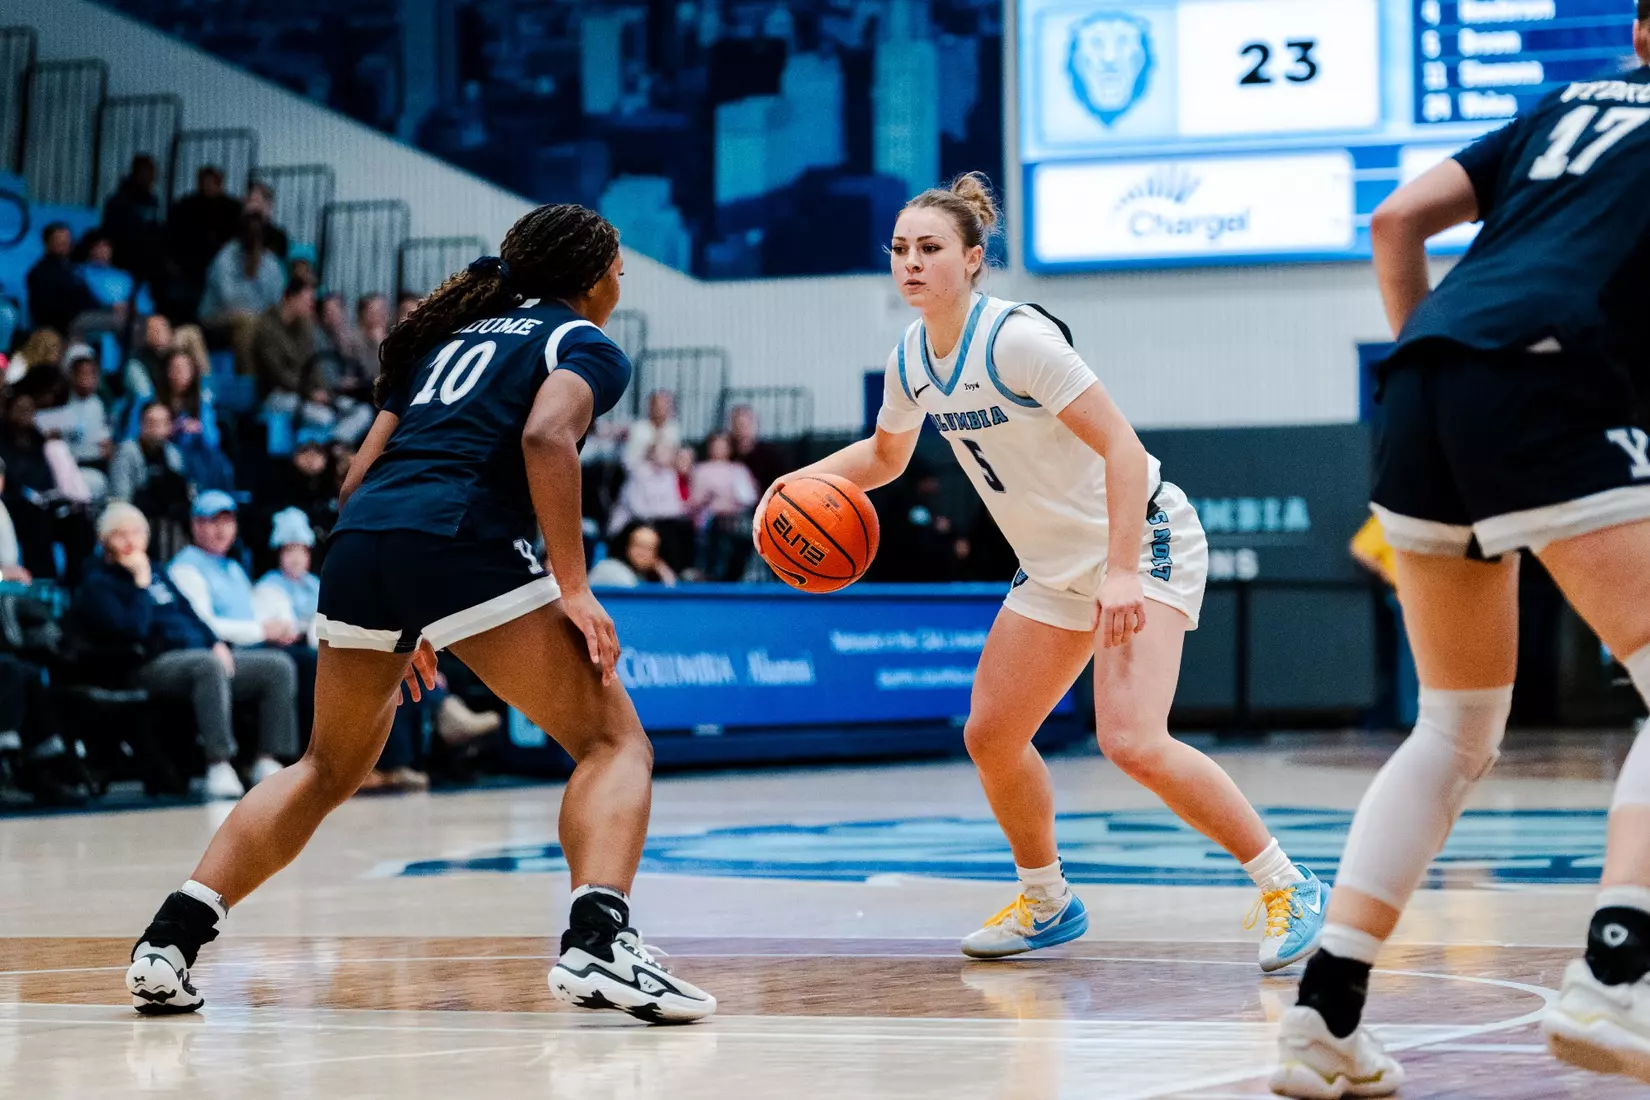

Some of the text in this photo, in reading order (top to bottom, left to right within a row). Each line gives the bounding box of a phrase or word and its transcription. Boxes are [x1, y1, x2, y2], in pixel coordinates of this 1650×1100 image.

[1239, 41, 1317, 84] 23
[1528, 104, 1650, 180] 17
[452, 317, 543, 336] DUME
[410, 340, 497, 405] 10
[959, 438, 1006, 493] 5
[1605, 427, 1650, 478] Y
[513, 538, 543, 574] Y
[772, 513, 826, 567] ELITE
[1148, 510, 1172, 581] LIONS
